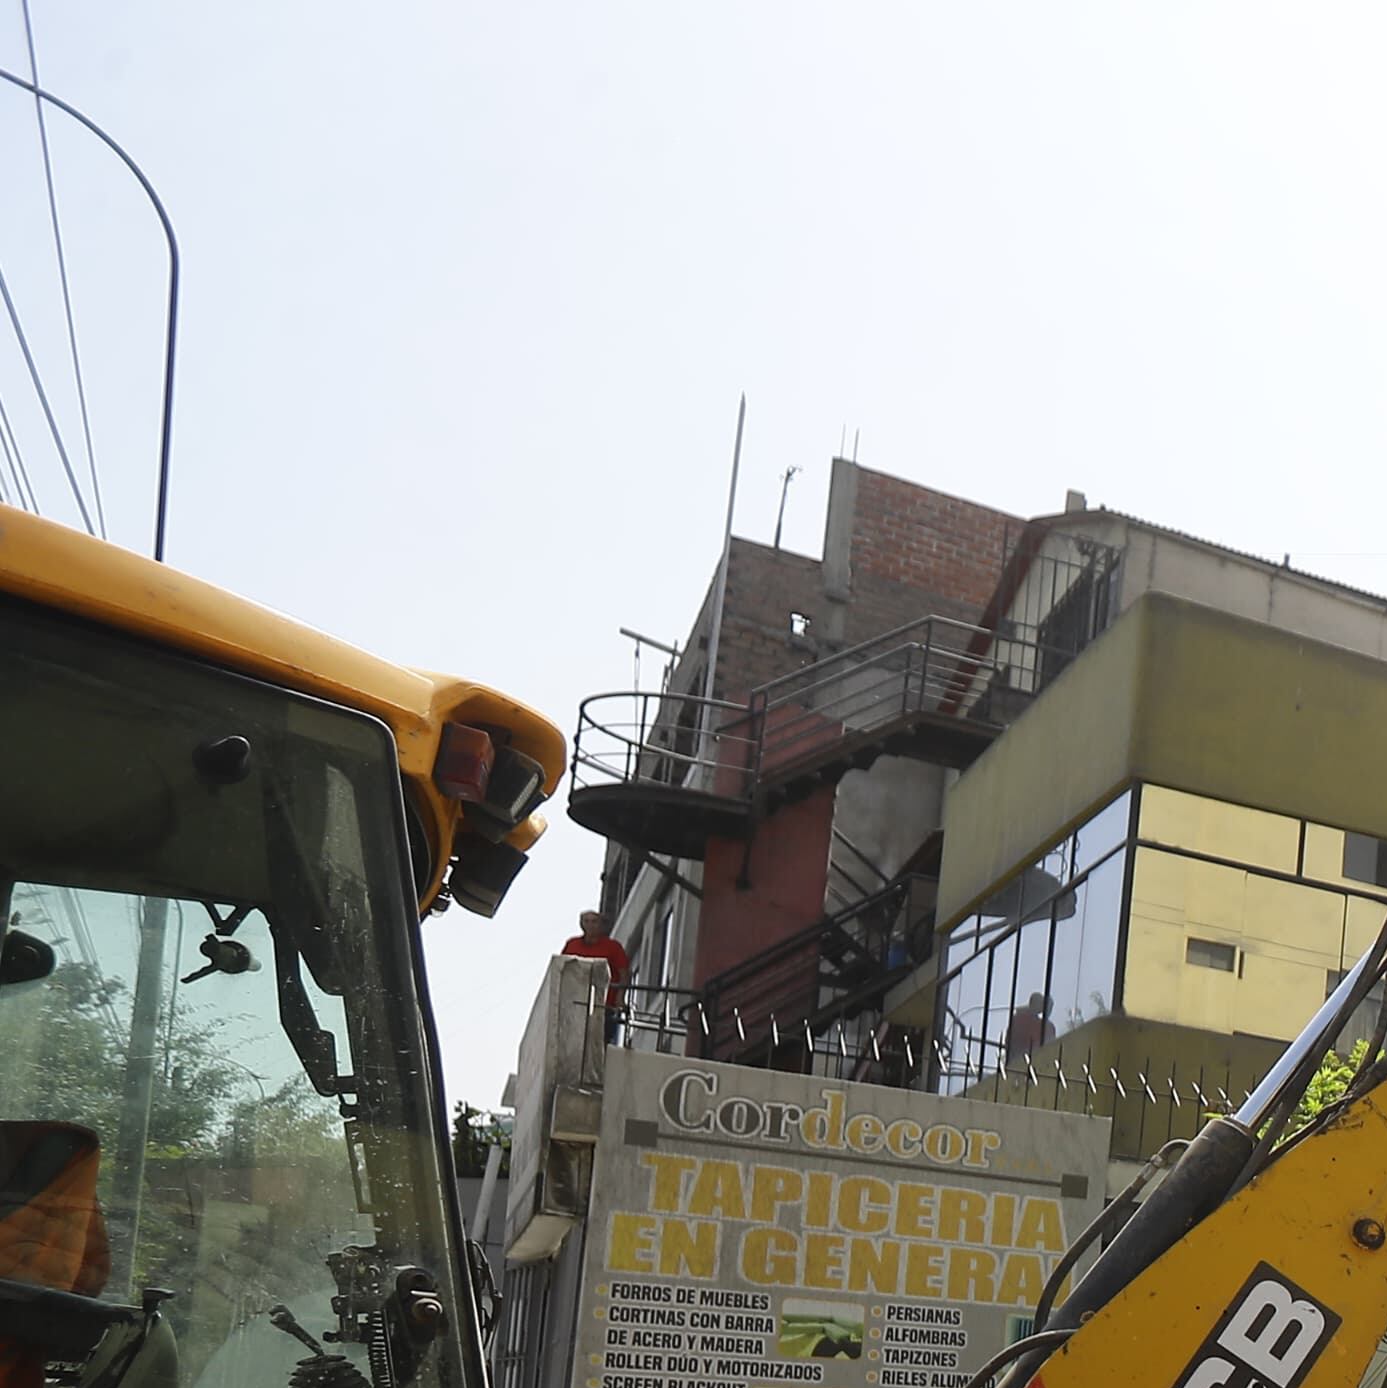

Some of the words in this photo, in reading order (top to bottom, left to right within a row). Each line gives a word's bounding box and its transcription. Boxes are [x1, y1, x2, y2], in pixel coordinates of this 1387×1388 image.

[660, 1068, 1001, 1169] Cordecor
[642, 1151, 1068, 1253] TAPICERIA
[605, 1210, 722, 1280] EN
[611, 1282, 672, 1304] FORROS
[675, 1288, 696, 1305] DE
[699, 1290, 770, 1311] MUEBLES
[608, 1306, 686, 1327] CORTINAS
[690, 1312, 721, 1330] CON
[724, 1315, 774, 1334] BARRA
[886, 1304, 962, 1326] PERSIANAS
[606, 1329, 628, 1346] DE
[631, 1331, 682, 1350] ACERO
[686, 1334, 697, 1350] Y
[700, 1336, 764, 1356] MADERA
[884, 1326, 967, 1347] ALFOMBRAS
[605, 1352, 663, 1372] ROLLER
[667, 1352, 699, 1374] DÚO
[703, 1358, 713, 1374] Y
[716, 1360, 823, 1382] MOTORIZADOS
[882, 1348, 958, 1368] TAPIZONES
[881, 1370, 928, 1387] RIELES
